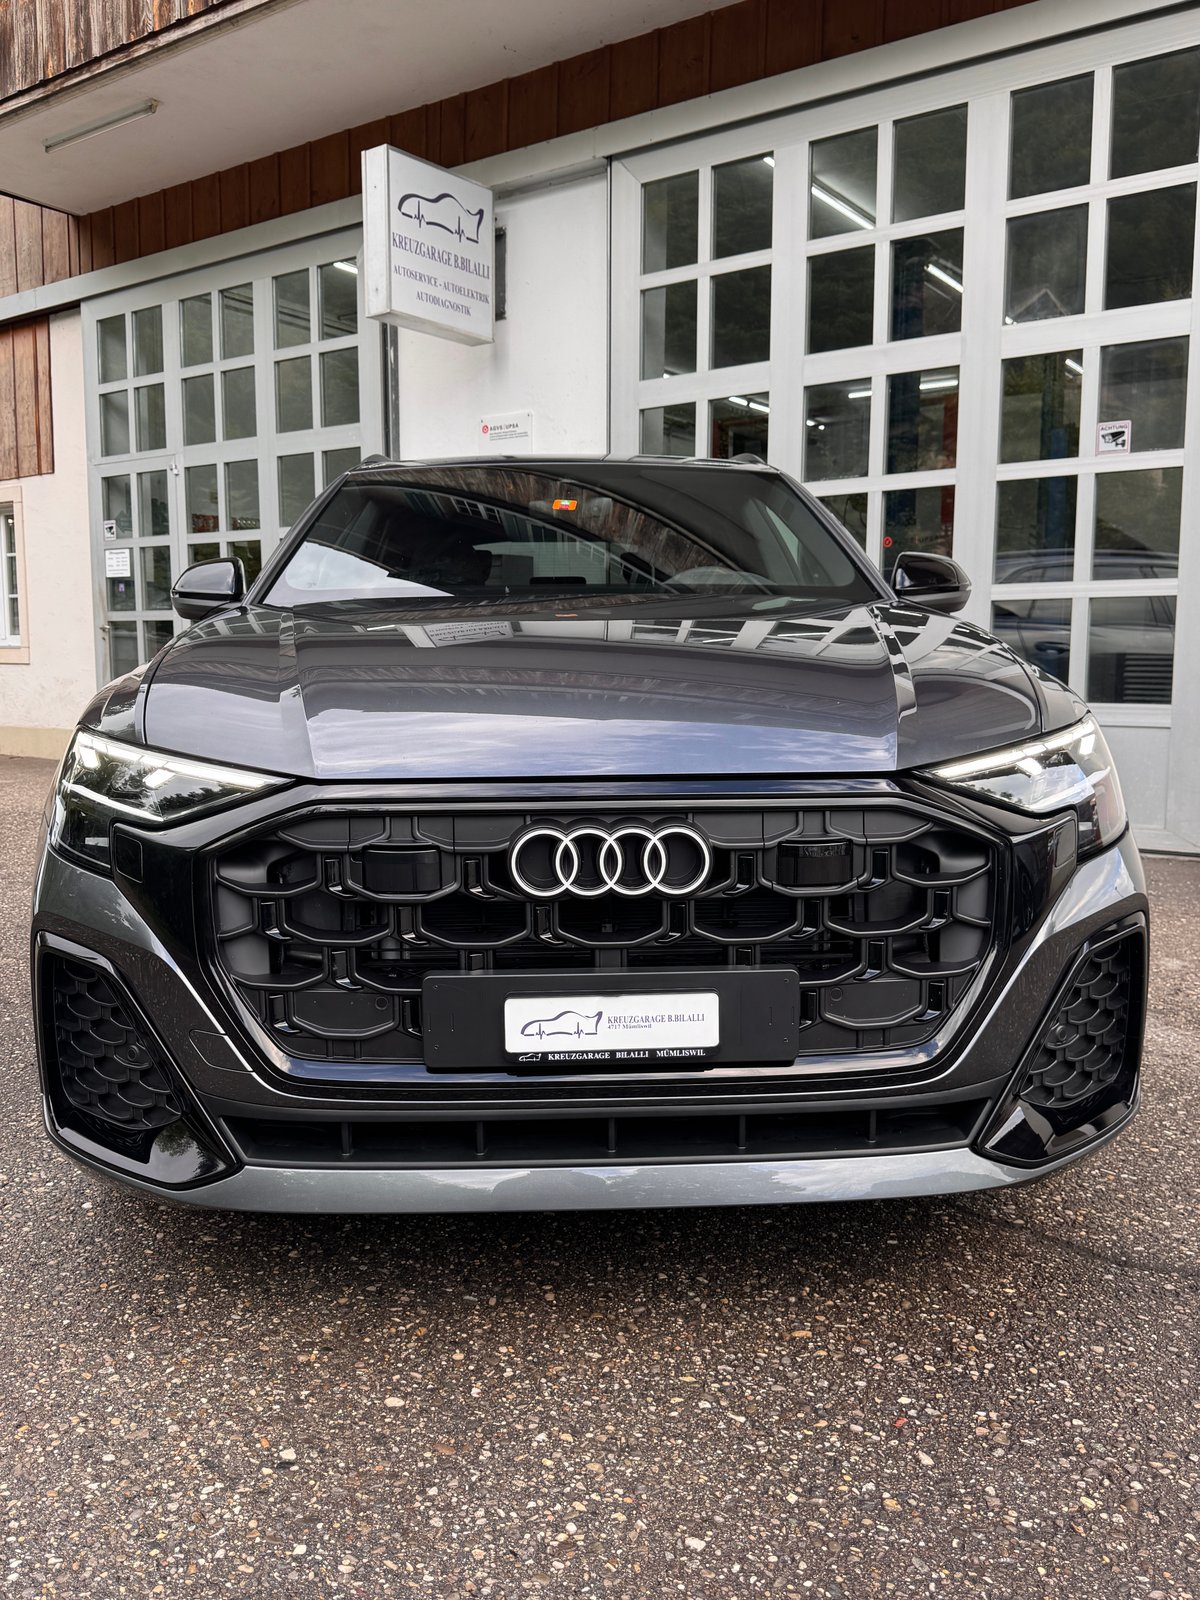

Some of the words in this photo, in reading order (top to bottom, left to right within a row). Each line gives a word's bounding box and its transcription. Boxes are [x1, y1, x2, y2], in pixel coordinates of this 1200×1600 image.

[392, 232, 453, 267] KREUZGARAGE
[453, 254, 490, 280] B.BILALLI
[393, 264, 438, 288] AUTOSERVICE
[443, 281, 490, 304] AUTOELEKTRIK
[416, 291, 471, 316] AUTODIAGNOSTIK
[607, 1014, 666, 1024] KREUZGARAGE
[667, 1013, 705, 1023] B.BILALLI
[548, 1052, 611, 1061] KREUZGARAGE
[615, 1050, 649, 1059] BILALLI
[656, 1048, 706, 1058] MÜMLISWIL
